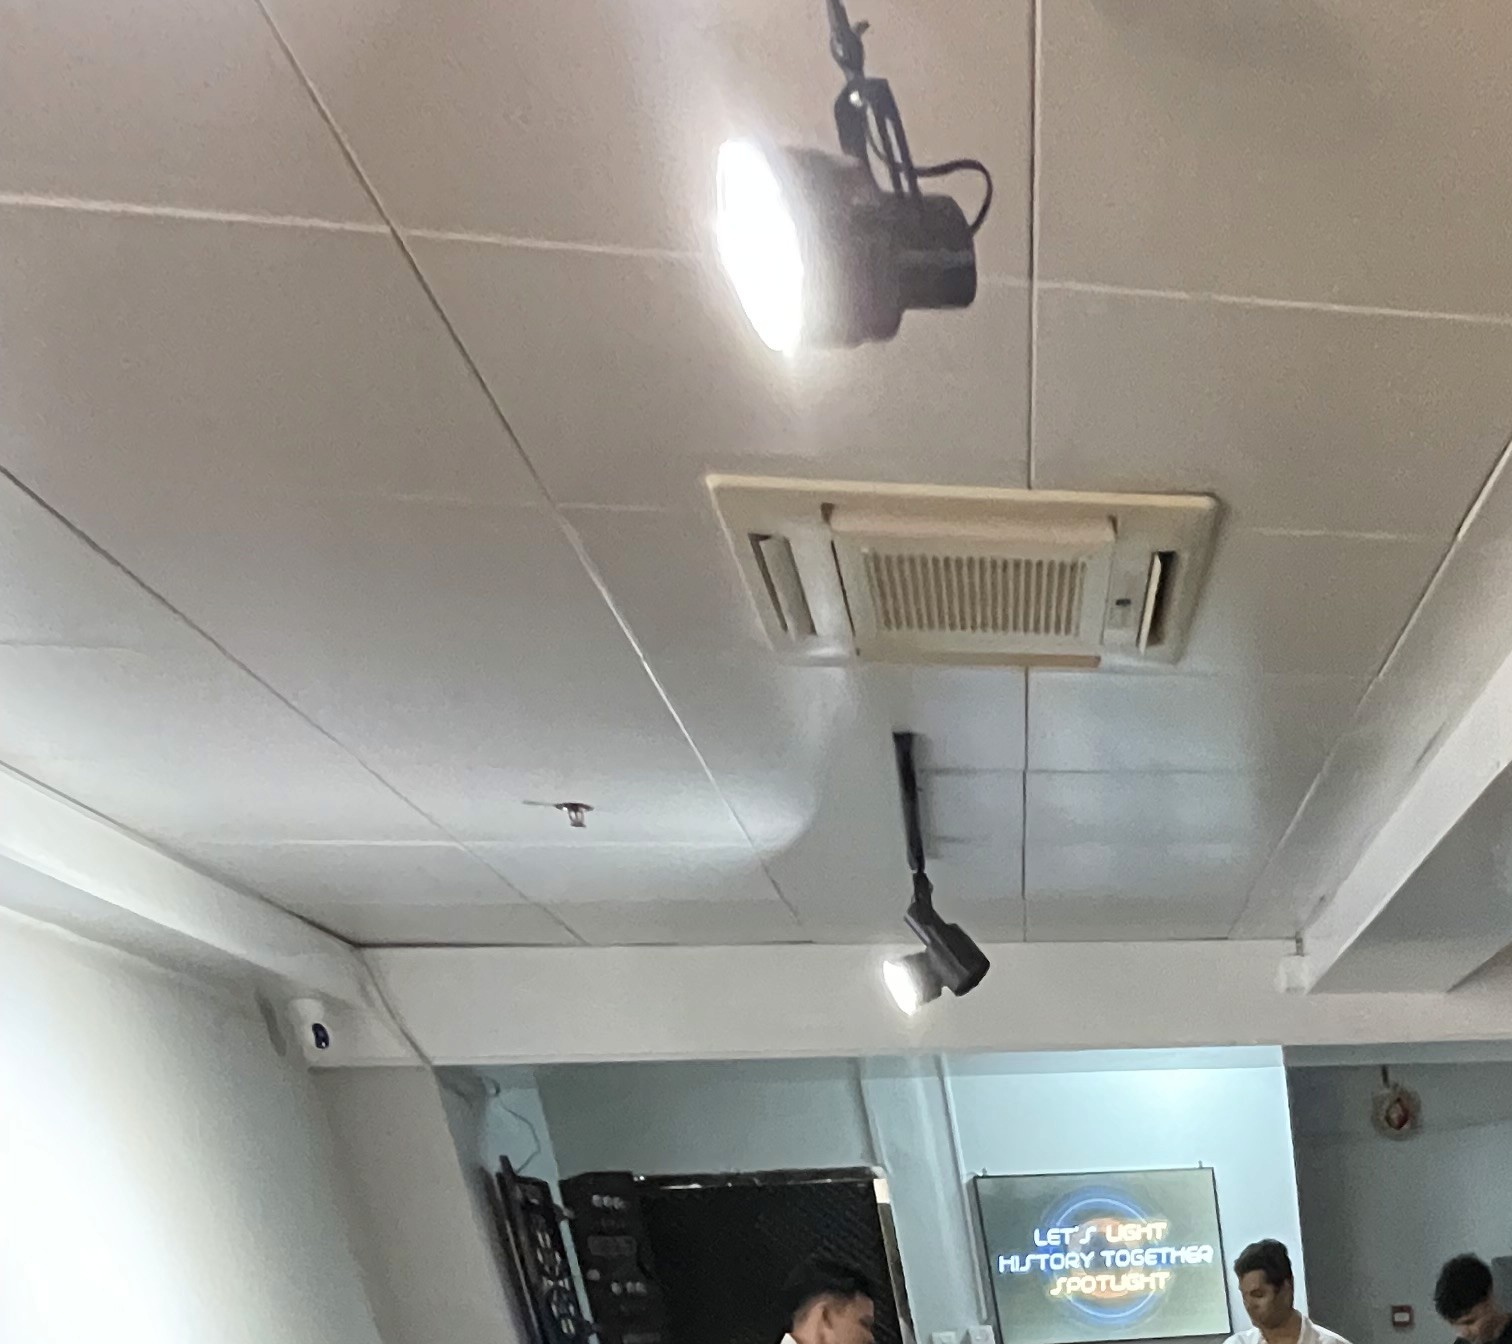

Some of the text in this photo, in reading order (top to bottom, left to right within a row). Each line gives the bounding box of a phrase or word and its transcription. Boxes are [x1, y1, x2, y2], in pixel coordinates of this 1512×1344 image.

[1033, 1221, 1168, 1247] LET'S LIGHT
[998, 1244, 1214, 1274] HISTORY TOGETHER
[1049, 1271, 1172, 1296] SPOTLIGHT
